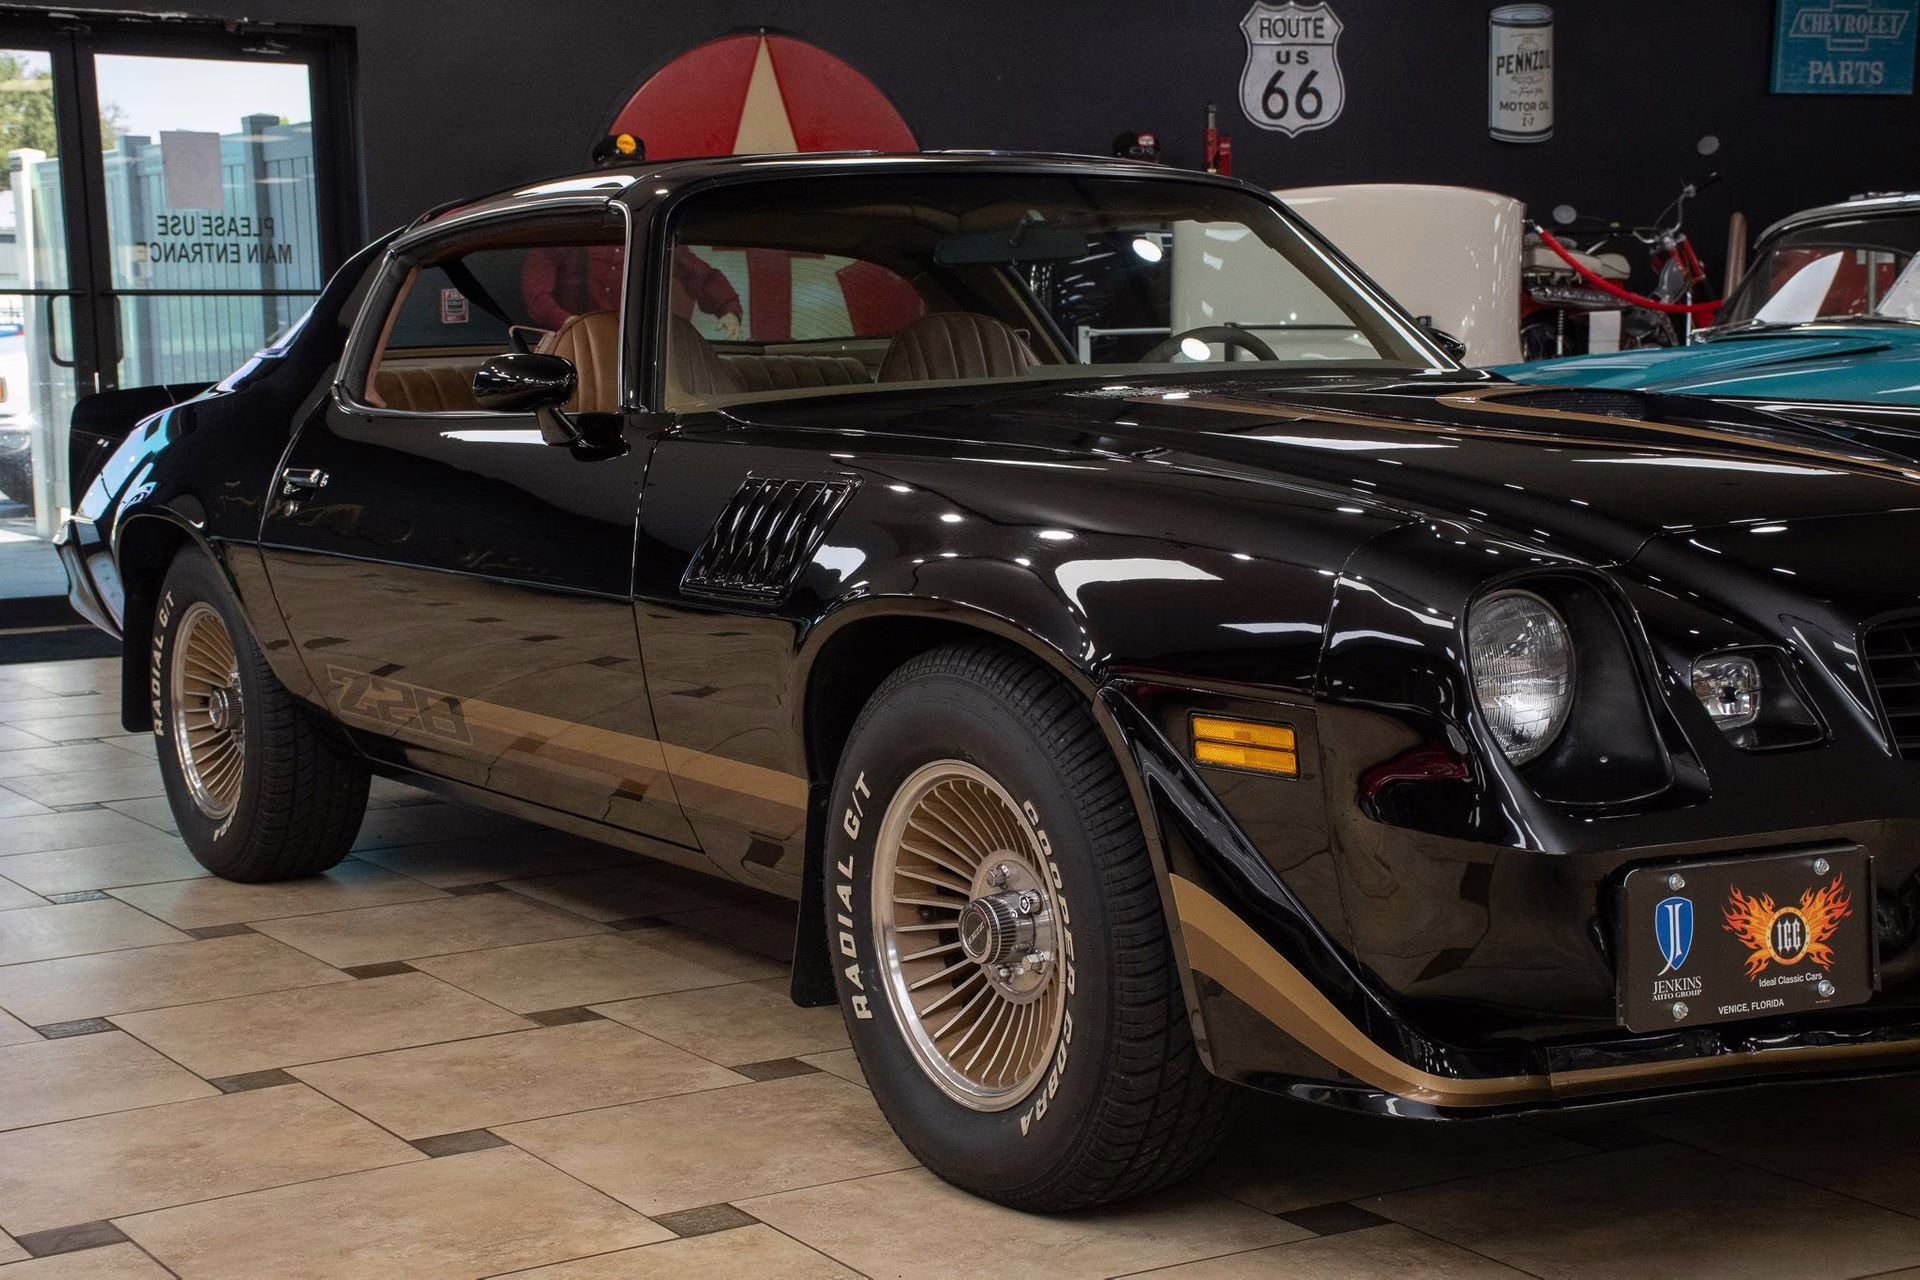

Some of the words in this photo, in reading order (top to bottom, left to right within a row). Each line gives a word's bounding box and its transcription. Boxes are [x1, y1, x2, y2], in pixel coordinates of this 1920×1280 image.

[1259, 17, 1324, 38] ROUTE
[1801, 13, 1899, 34] CHEVROLET
[1807, 61, 1884, 85] PARTS
[1261, 69, 1323, 120] 66
[1499, 101, 1537, 112] MOTOR
[151, 634, 165, 736] RADIAL
[158, 591, 176, 628] G/T
[326, 663, 474, 747] Z28
[842, 771, 872, 842] G/T
[1022, 800, 1076, 996] COOPER
[836, 855, 873, 1020] RADIAL
[1652, 976, 1702, 995] JENKINS
[1759, 976, 1777, 987] Ideal
[1777, 973, 1804, 985] Classic
[1805, 971, 1823, 982] Cars
[1652, 992, 1674, 1001] AUTO
[1675, 989, 1702, 999] GROUP
[1718, 1003, 1750, 1015] VENICE,
[1751, 998, 1785, 1011] FLORIDA
[1020, 1008, 1073, 1137] COBRA
